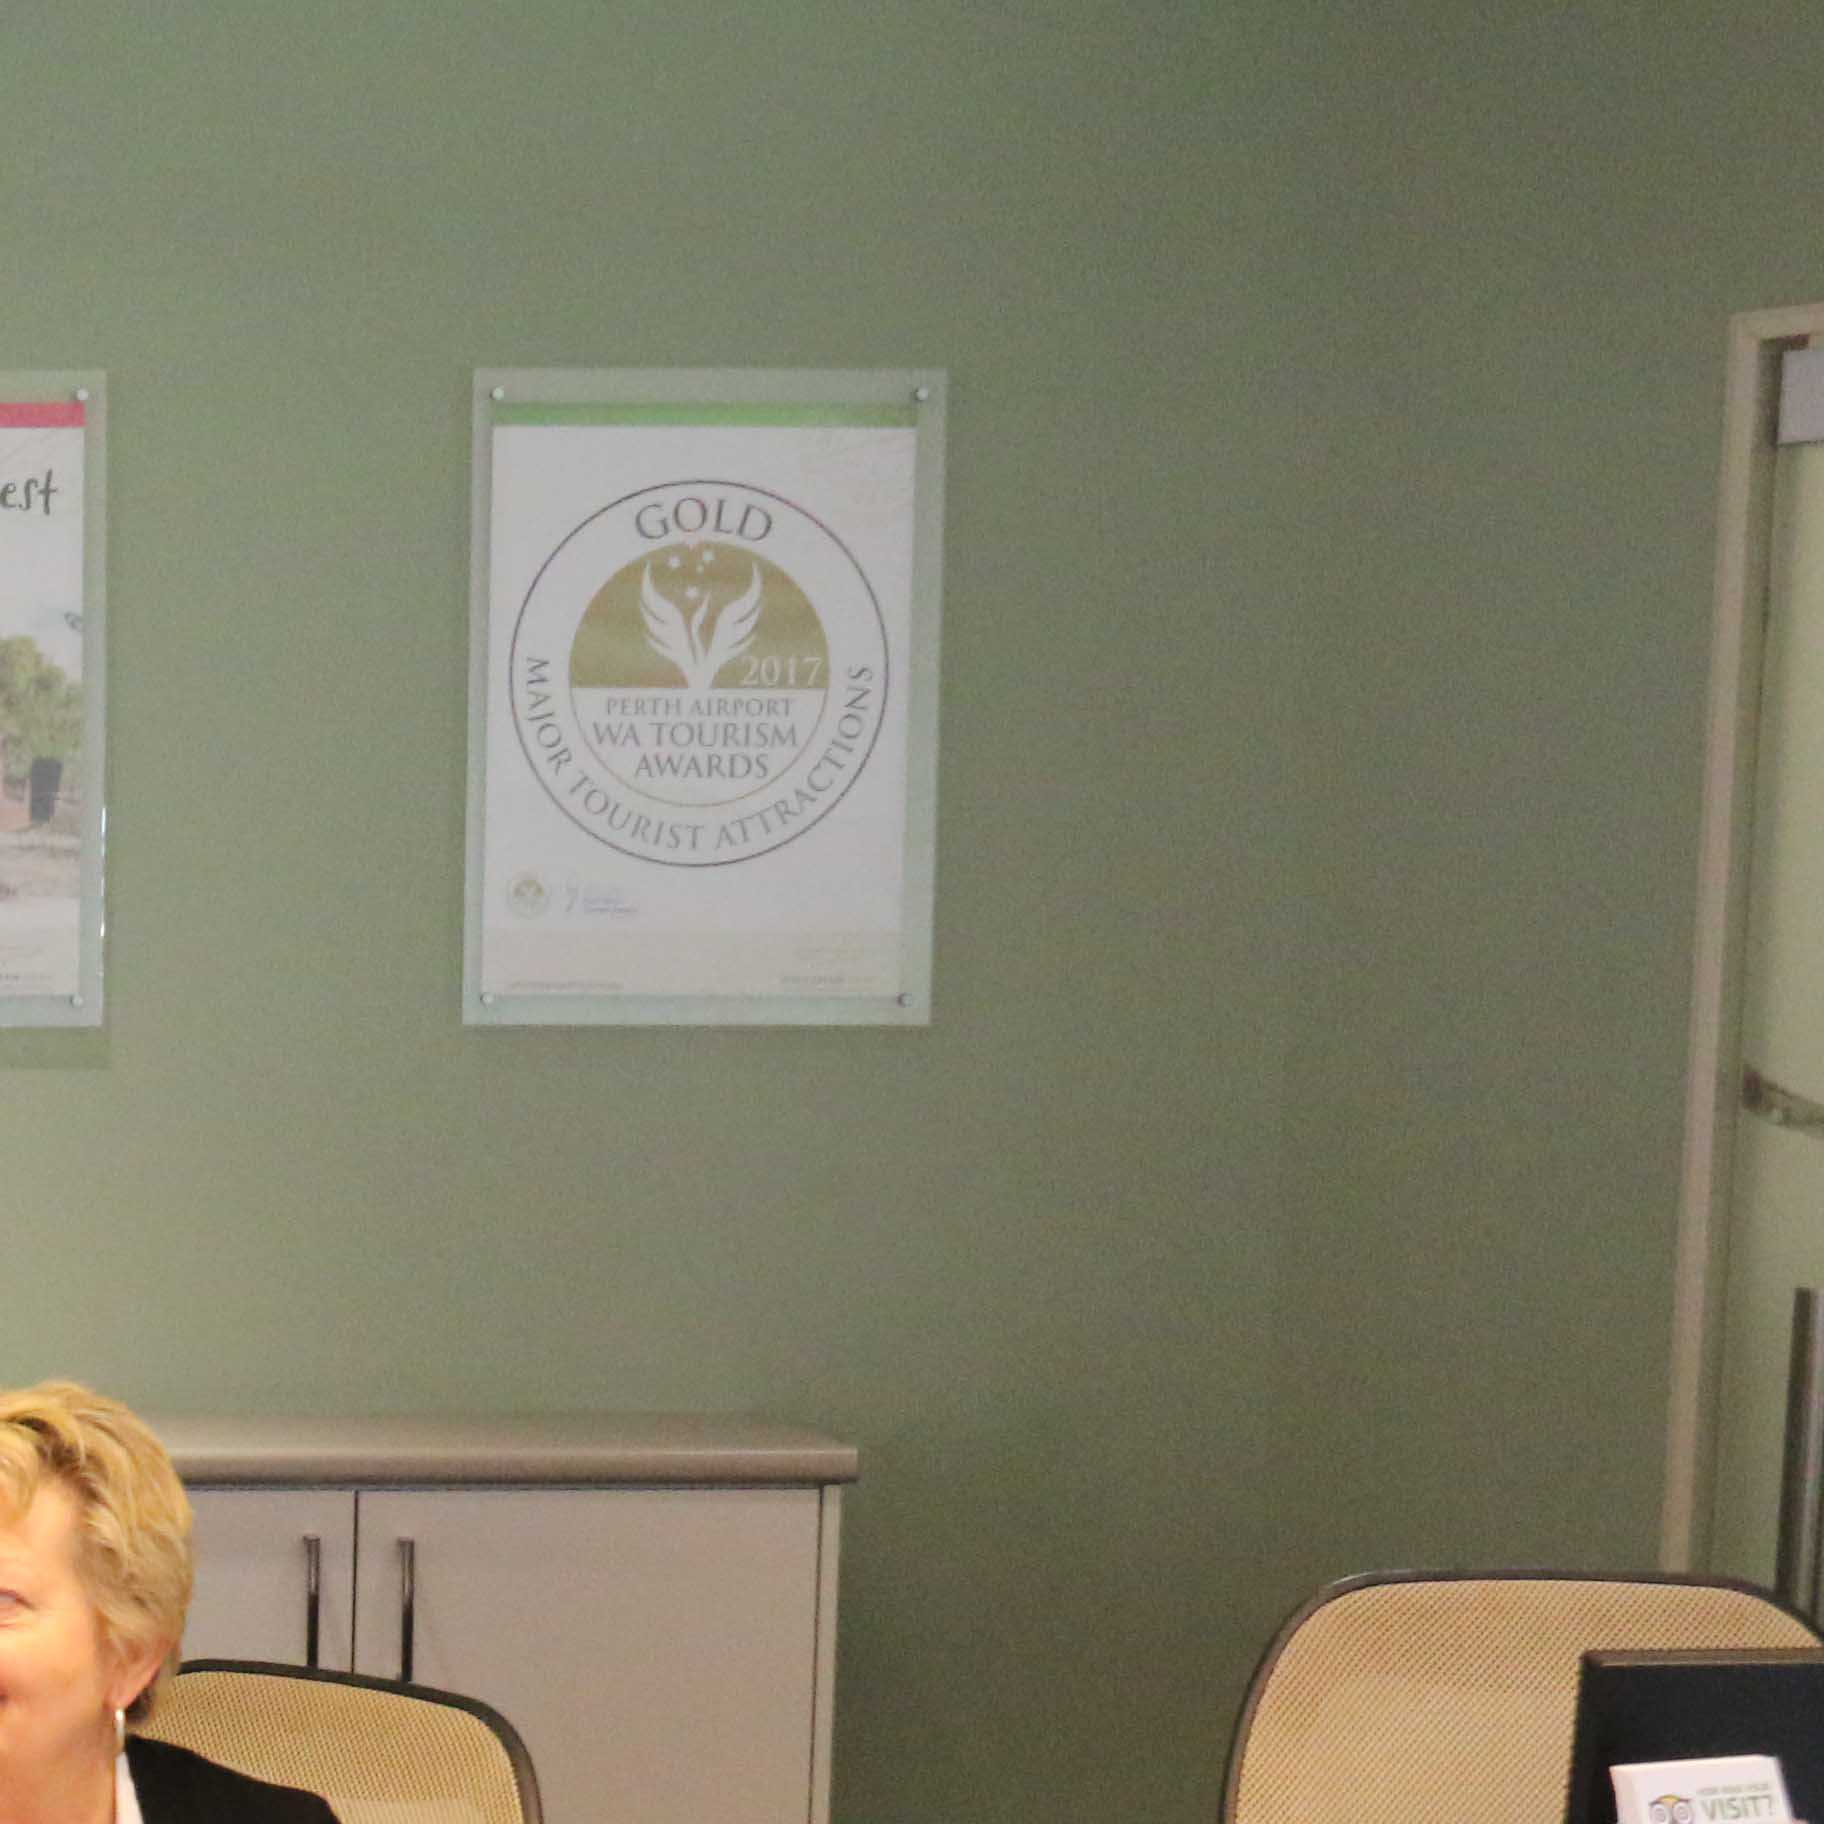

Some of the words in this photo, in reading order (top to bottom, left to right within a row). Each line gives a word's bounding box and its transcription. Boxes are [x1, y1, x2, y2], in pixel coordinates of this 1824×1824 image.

[635, 497, 772, 541] GOLD
[740, 656, 822, 686] 2017
[605, 698, 678, 717] PERTH
[689, 698, 794, 717] AIRPORT
[594, 723, 640, 747] WA
[652, 722, 797, 747] TOURISM
[526, 656, 572, 777] MAJOR
[569, 774, 703, 850] TOURIST
[715, 664, 873, 849] ATTRACTIONS
[634, 753, 769, 779] AWARDS
